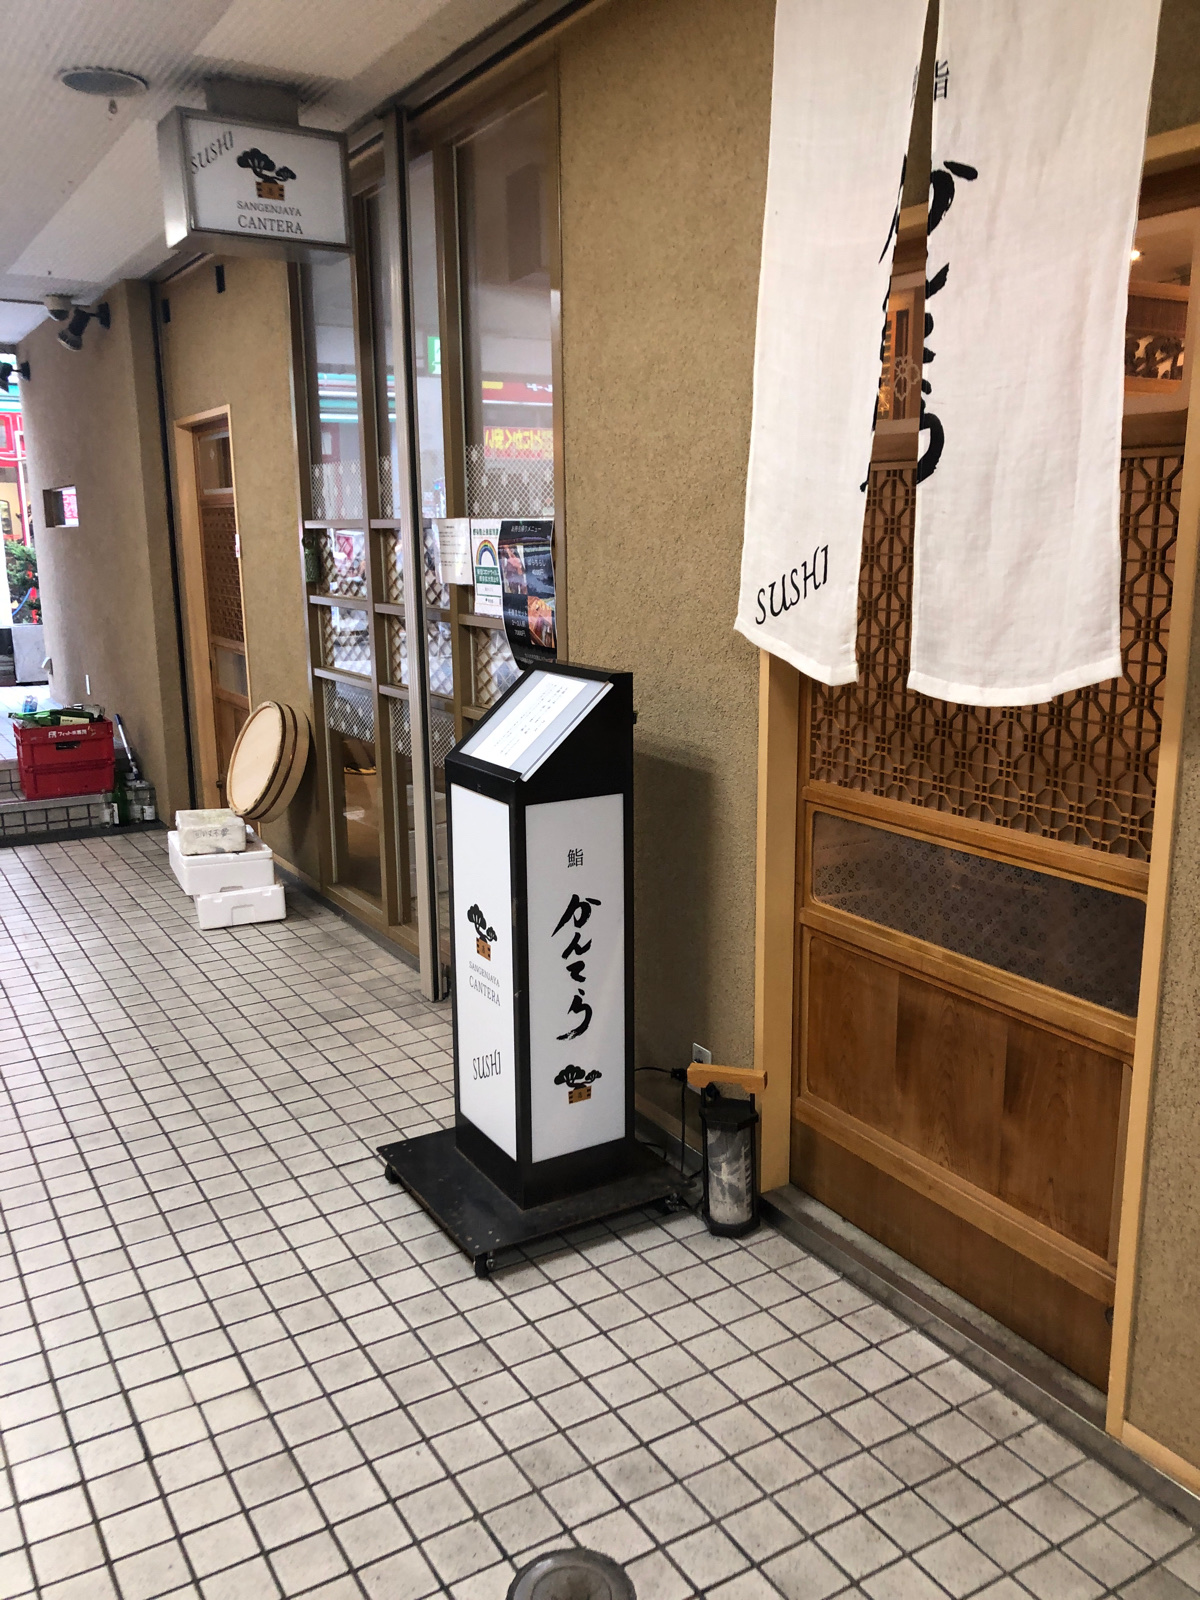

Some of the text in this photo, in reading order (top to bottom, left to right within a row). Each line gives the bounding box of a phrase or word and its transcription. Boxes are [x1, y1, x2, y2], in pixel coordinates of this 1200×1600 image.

[190, 131, 234, 175] SUSHI
[236, 200, 302, 217] SANGENJAYA
[237, 214, 304, 235] CANTERA
[755, 545, 830, 625] SUSHI
[550, 848, 602, 1041] 鮨 かんてら
[468, 960, 500, 988] SANGENJAYA
[468, 975, 501, 1007] CANTERA
[472, 1049, 502, 1081] SUSHI
